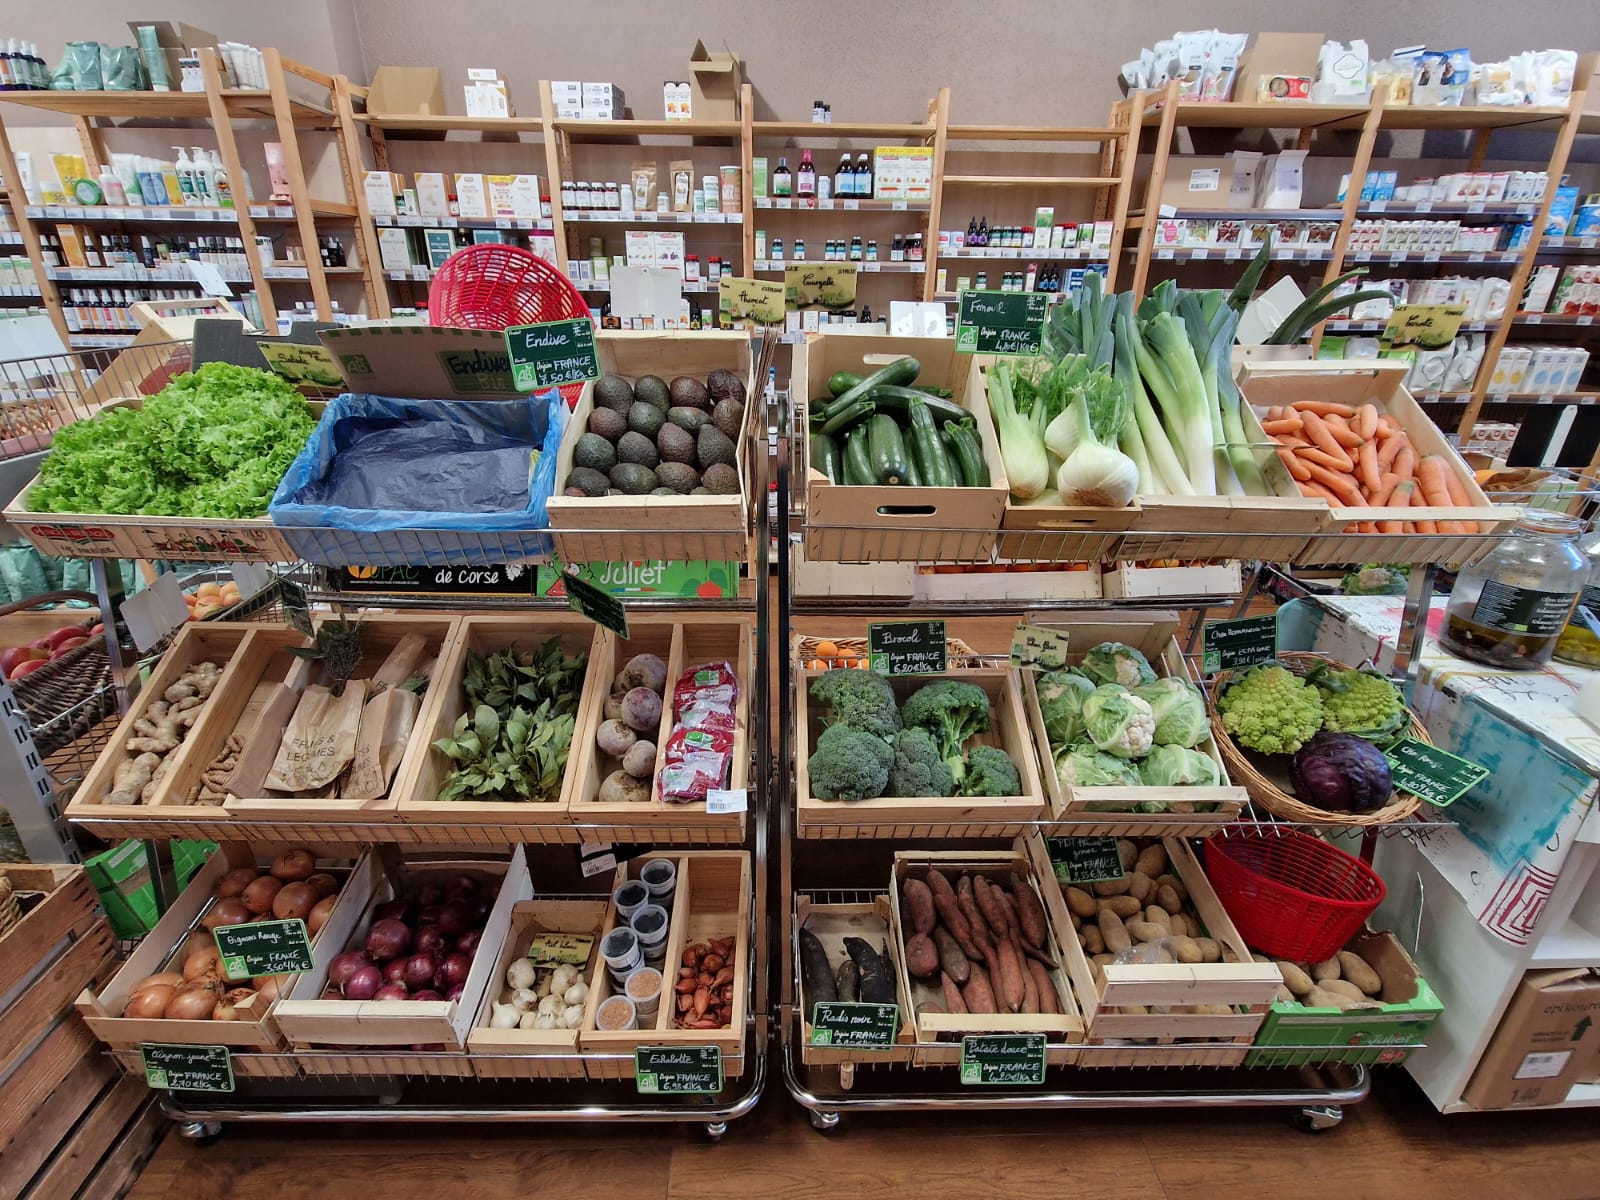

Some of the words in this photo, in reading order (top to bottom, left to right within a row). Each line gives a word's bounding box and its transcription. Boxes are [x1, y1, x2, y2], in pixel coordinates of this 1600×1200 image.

[525, 329, 570, 348] Endive
[1000, 329, 1031, 341] FRANCE
[553, 356, 591, 371] FRANCE
[435, 569, 453, 584] de
[458, 569, 500, 584] Corse
[600, 560, 666, 585] Juliet
[907, 651, 940, 662] FRANCE
[1414, 772, 1452, 793] FRANCE
[1083, 857, 1116, 870] FRANCE
[269, 949, 301, 962] FRANCE
[822, 1009, 849, 1023] Radis
[849, 1031, 888, 1040] FRANCE
[999, 1063, 1040, 1072] FRANCE
[184, 1072, 222, 1081] FRANCE
[676, 1073, 711, 1082] FRANCE
